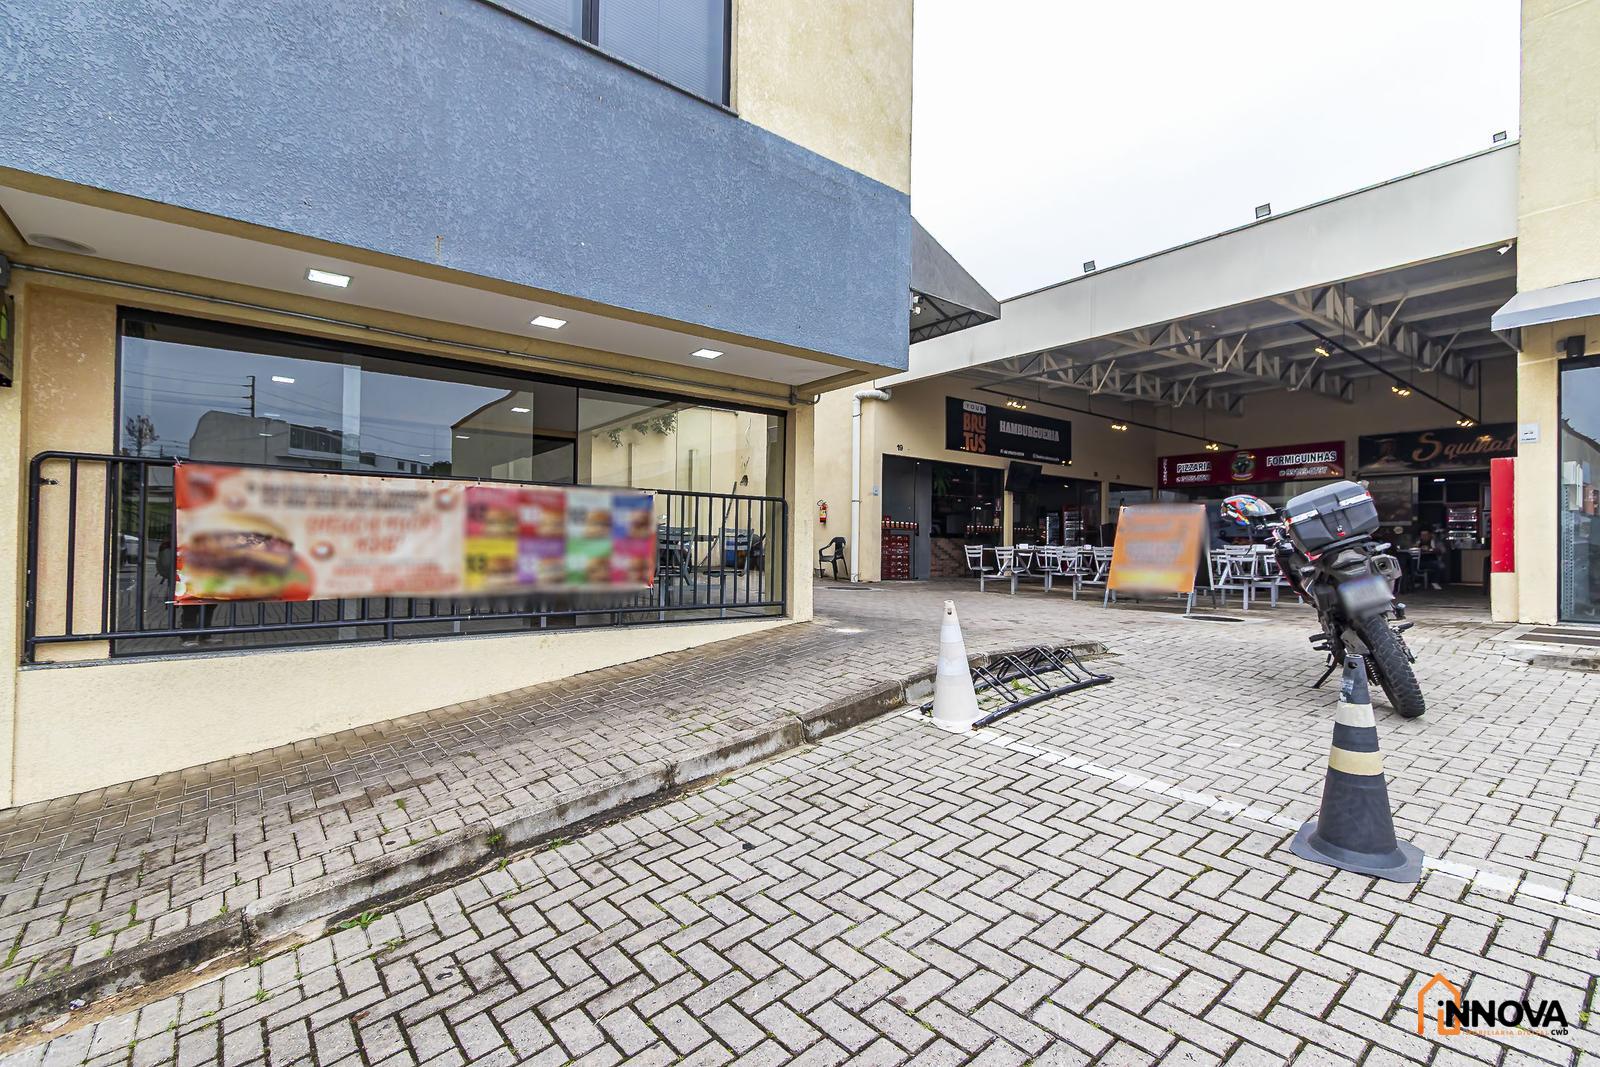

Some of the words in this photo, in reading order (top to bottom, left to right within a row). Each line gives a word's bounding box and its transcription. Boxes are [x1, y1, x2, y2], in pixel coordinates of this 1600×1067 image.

[965, 403, 985, 413] YOUR
[963, 412, 986, 433] BRU
[999, 420, 1060, 442] HAMBURGUERIA
[1266, 451, 1337, 467] FORMIGUINHAS
[1176, 461, 1212, 474] PIZZARIA
